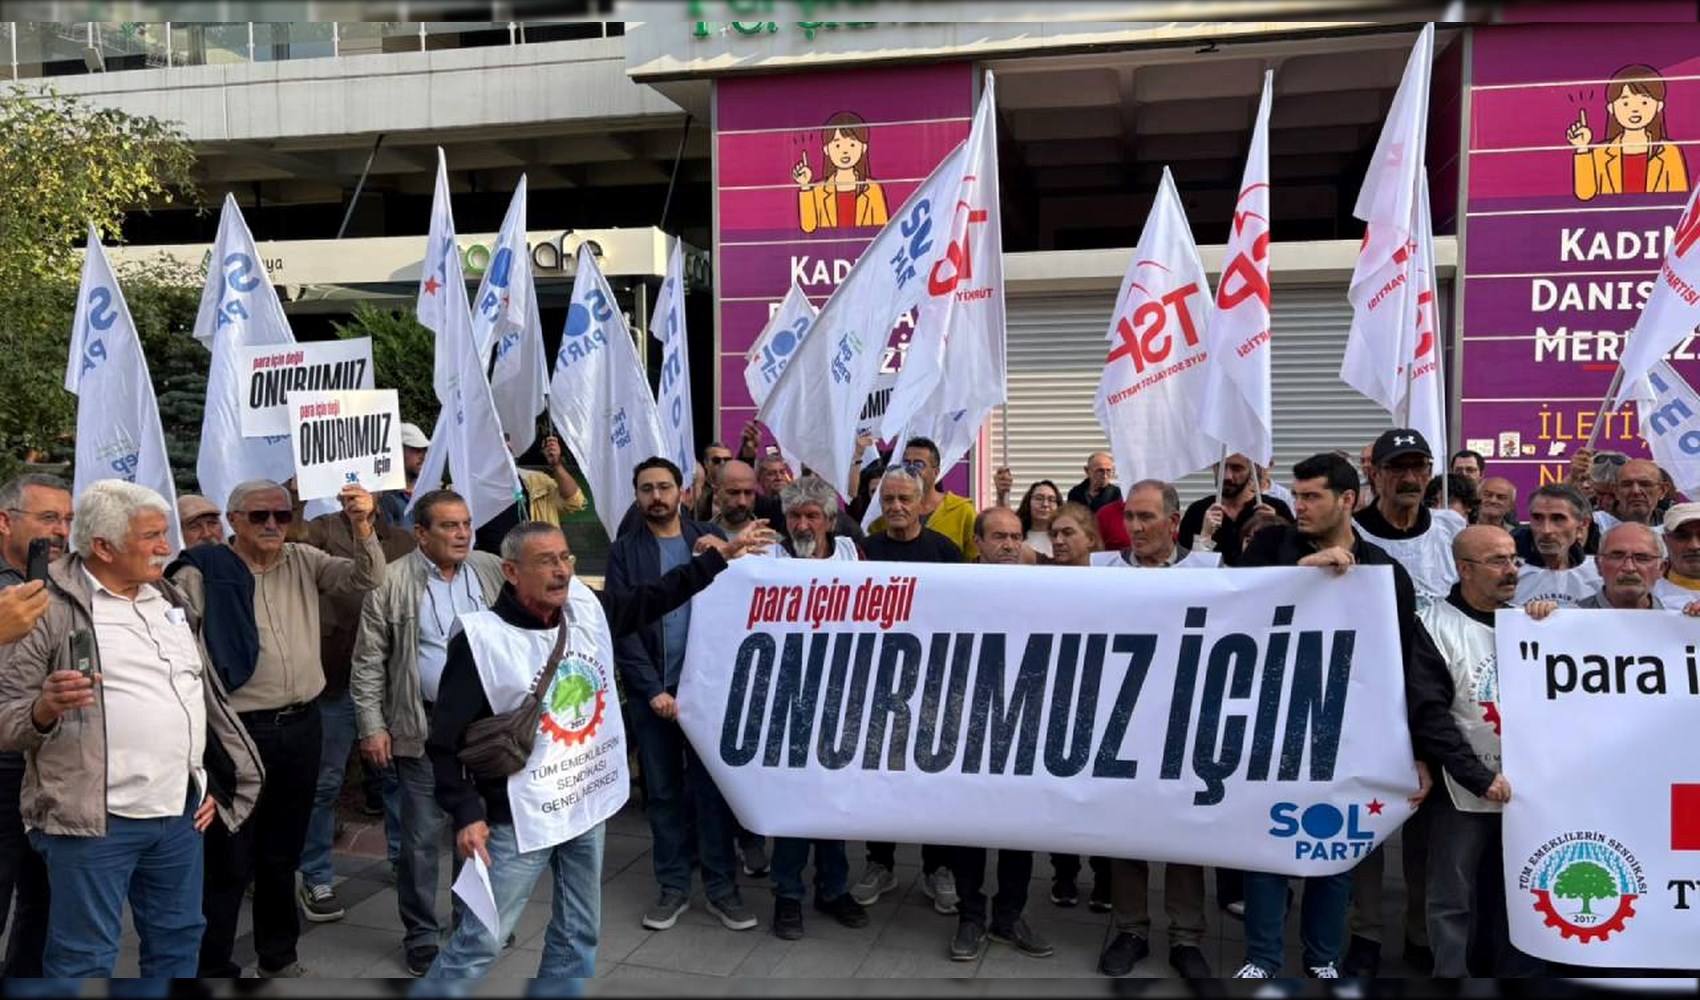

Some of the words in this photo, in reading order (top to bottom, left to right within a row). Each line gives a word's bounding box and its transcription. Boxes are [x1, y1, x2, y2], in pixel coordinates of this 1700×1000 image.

[300, 412, 391, 466] ONURUMUZ
[374, 455, 391, 477] için
[746, 584, 804, 631] para
[803, 577, 851, 631] için
[852, 575, 918, 631] değil
[1519, 641, 1667, 700] "para
[719, 631, 1159, 780] ONURUMUZ
[1160, 604, 1357, 806] İÇİN
[530, 764, 559, 783] TÜM
[556, 758, 608, 791] SENDİKASI
[541, 791, 581, 814] GENEL
[1269, 802, 1375, 840] SOL
[1528, 830, 1607, 867] EMEKLİLERİN
[1606, 838, 1648, 895] SENDİKASI
[1573, 914, 1597, 924] 2017
